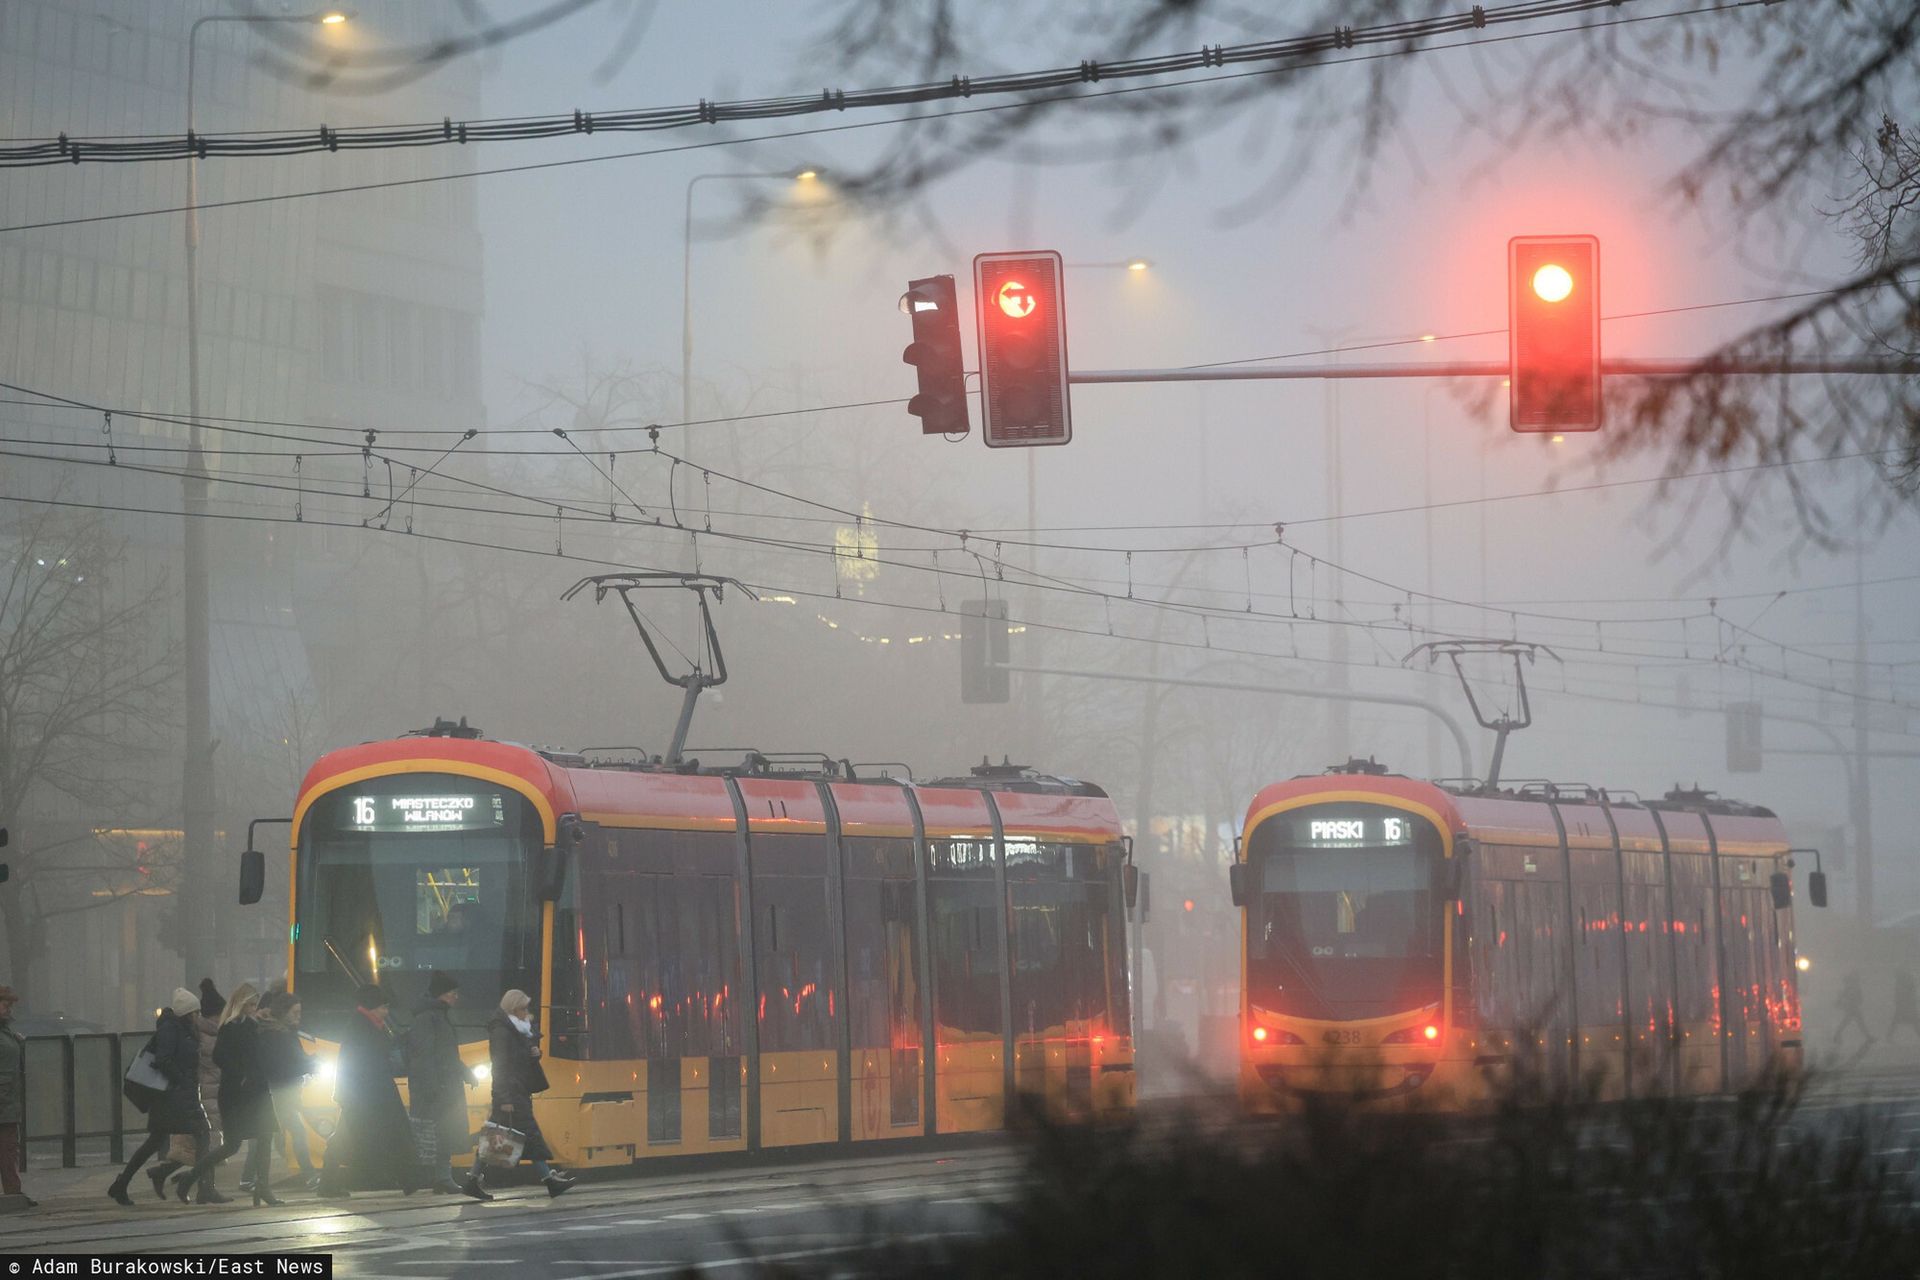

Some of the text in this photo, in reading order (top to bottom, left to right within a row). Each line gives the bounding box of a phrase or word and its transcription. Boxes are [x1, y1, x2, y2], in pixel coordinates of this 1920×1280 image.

[353, 797, 375, 824] 16
[391, 797, 474, 810] MIASTECZKO
[404, 809, 463, 822] WILANÓW
[1310, 818, 1402, 840] PIASKI 16
